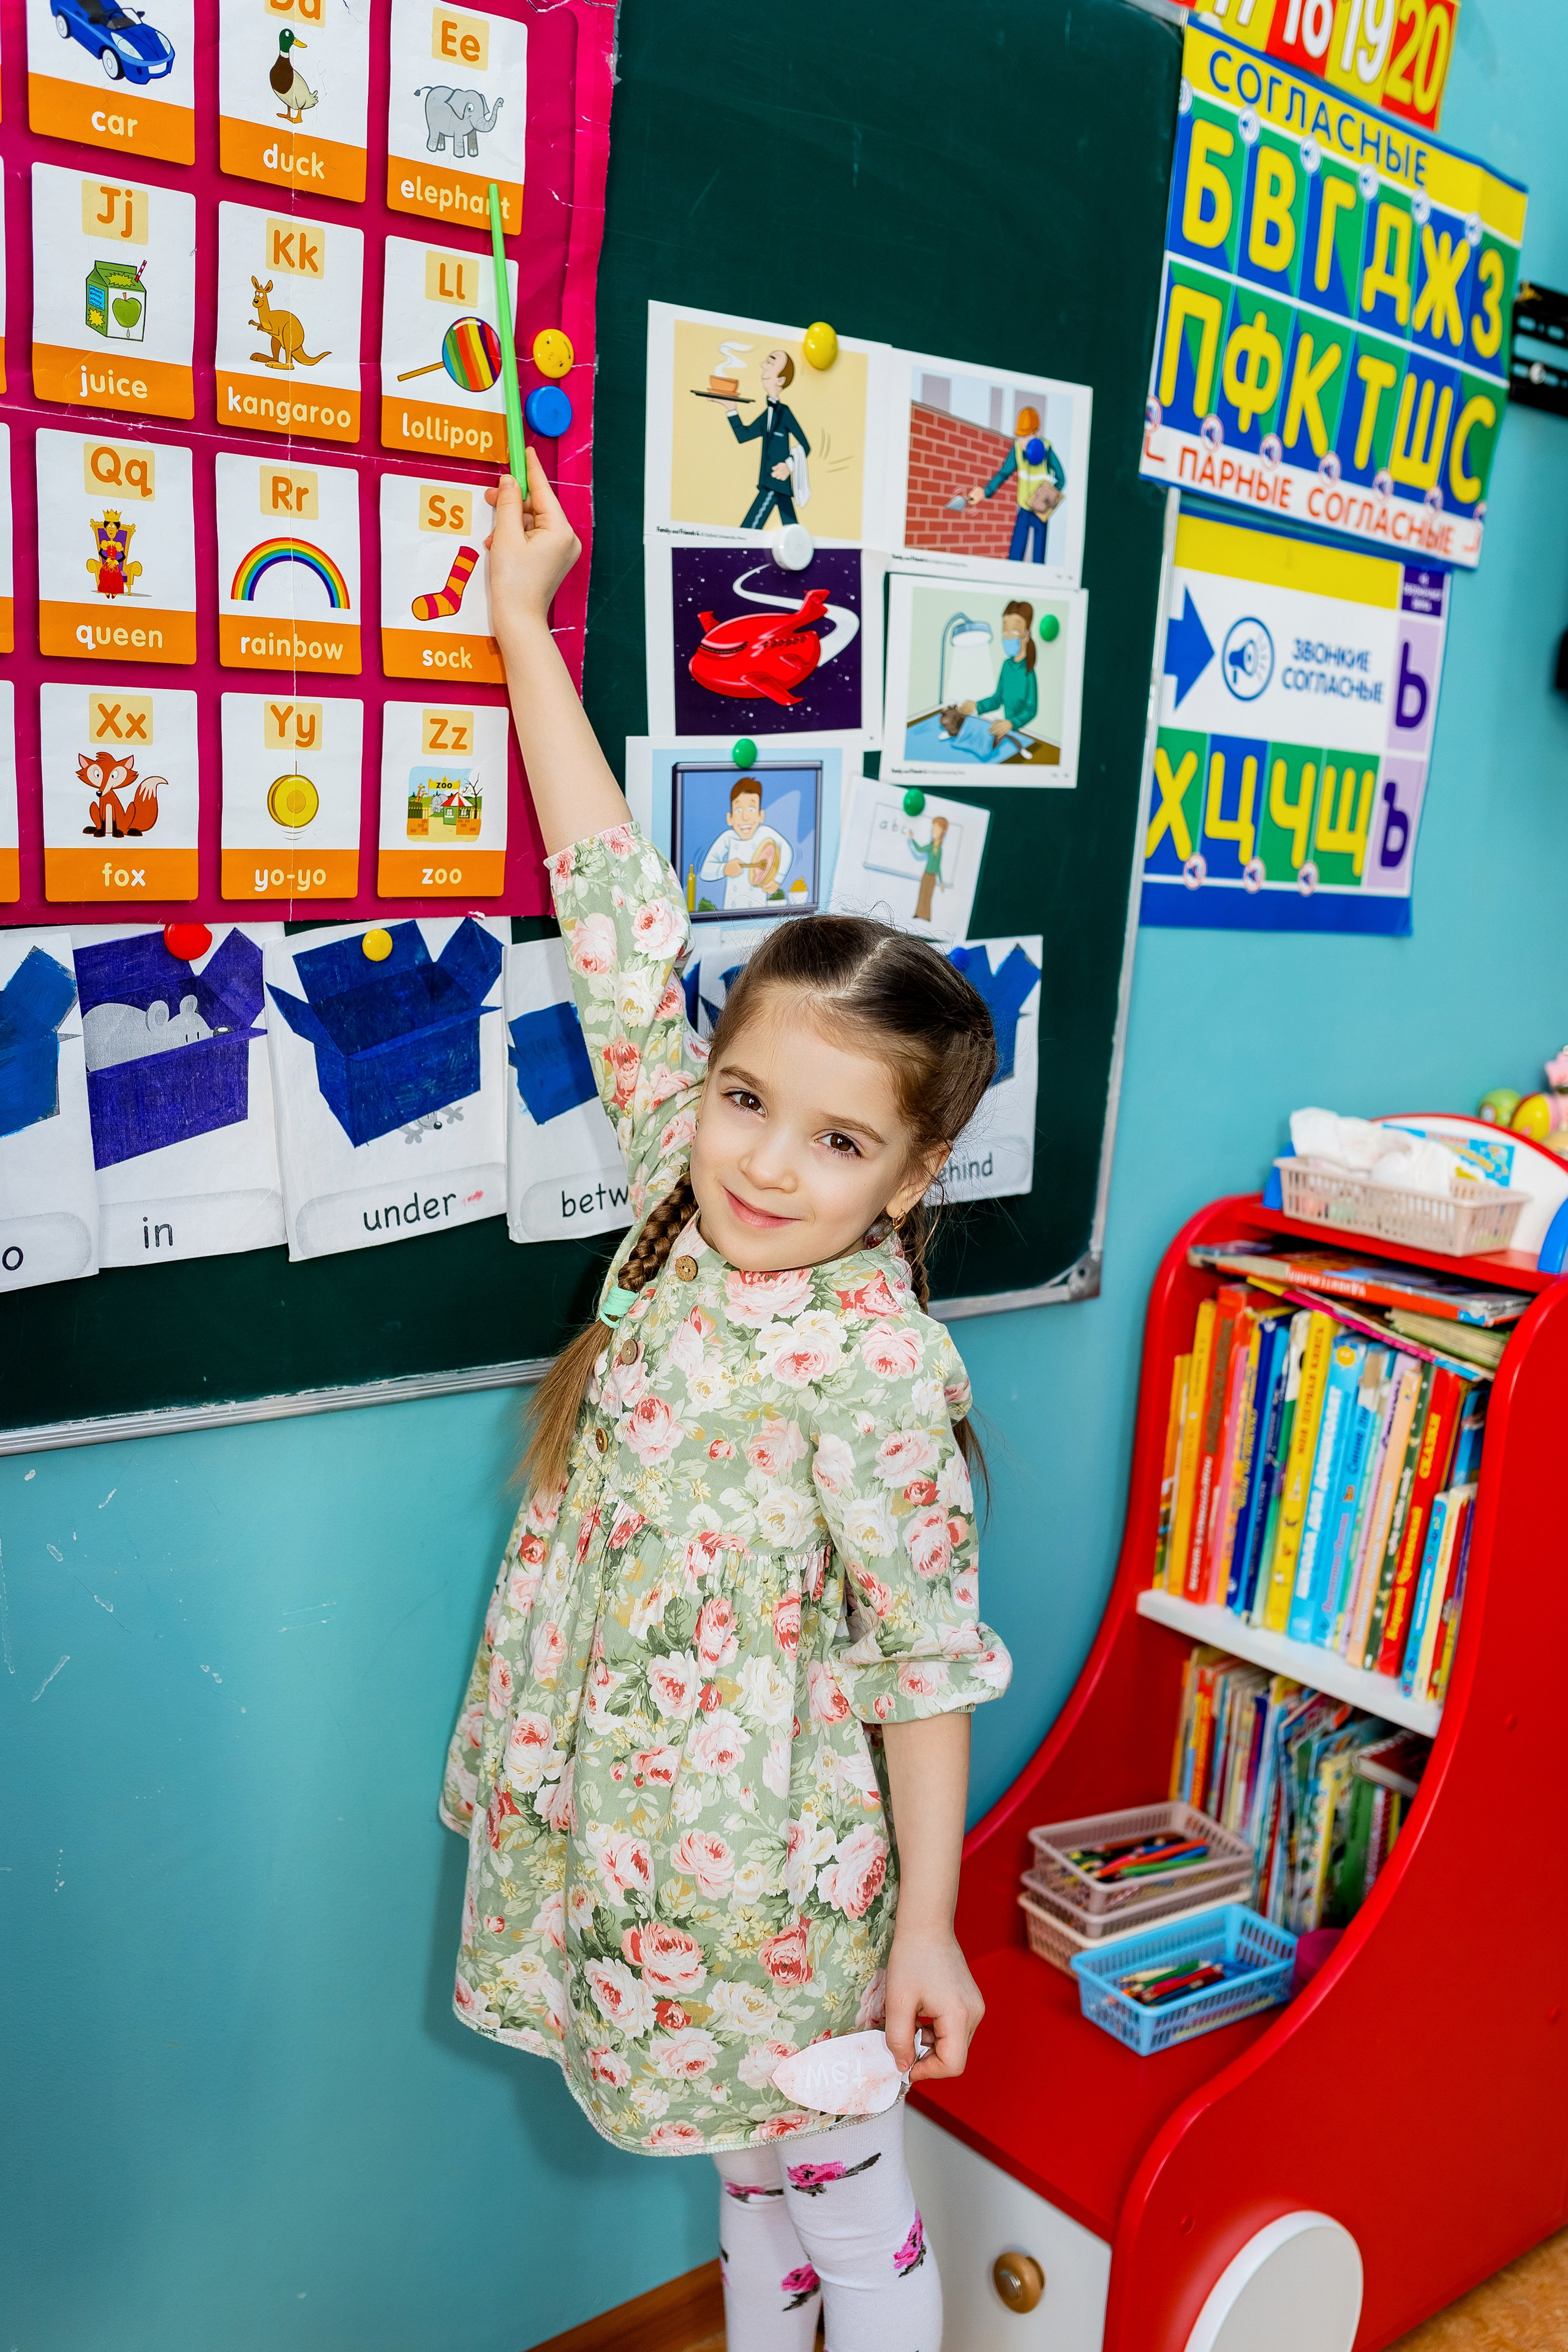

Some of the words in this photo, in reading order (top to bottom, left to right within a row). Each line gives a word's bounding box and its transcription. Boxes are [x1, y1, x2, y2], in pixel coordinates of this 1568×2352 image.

[440, 20, 481, 63] Ee
[1384, 0, 1450, 115] 20
[91, 107, 138, 139] car
[1210, 48, 1427, 186] СОГЛАСНЫЕ
[263, 143, 325, 181] duck
[97, 186, 135, 239] Jj
[401, 176, 510, 219] elephat
[273, 229, 320, 274] Kk
[1182, 118, 1234, 249] Б
[1248, 145, 1296, 273] В
[1315, 175, 1356, 292] Г
[1360, 202, 1413, 326] Д
[1413, 224, 1469, 347] Ж
[439, 263, 466, 301] Ll
[78, 365, 148, 401] juice
[1159, 284, 1223, 419] П
[1223, 311, 1283, 434] Ф
[1388, 372, 1454, 491] Ш
[227, 386, 352, 430] kangaroo
[401, 412, 494, 450] lollipop
[90, 447, 153, 498] Qq
[272, 476, 310, 513] Rr
[428, 494, 465, 531] Ss
[1178, 446, 1293, 510] ПАРНЫЕ
[1306, 488, 1455, 555] СОГЛАСНЫЕ
[75, 624, 163, 654] queen
[240, 633, 344, 663] rainbow
[422, 646, 473, 669] sock
[1293, 638, 1370, 673] ЗВОНКИЕ
[1282, 666, 1384, 704] СОГЛАСНЫЕ
[97, 704, 148, 740] Xx
[270, 704, 316, 748] Yy
[429, 718, 468, 751] Zz
[1204, 752, 1257, 865] Ц
[1268, 758, 1316, 869] Ч
[1314, 764, 1376, 876] Щ
[102, 863, 146, 888] fox
[254, 866, 327, 893] yo-yo
[422, 866, 462, 884] zoo
[937, 1152, 993, 1183] ehind
[363, 1191, 457, 1233] under
[562, 1183, 628, 1218] betw
[143, 1216, 173, 1249] in
